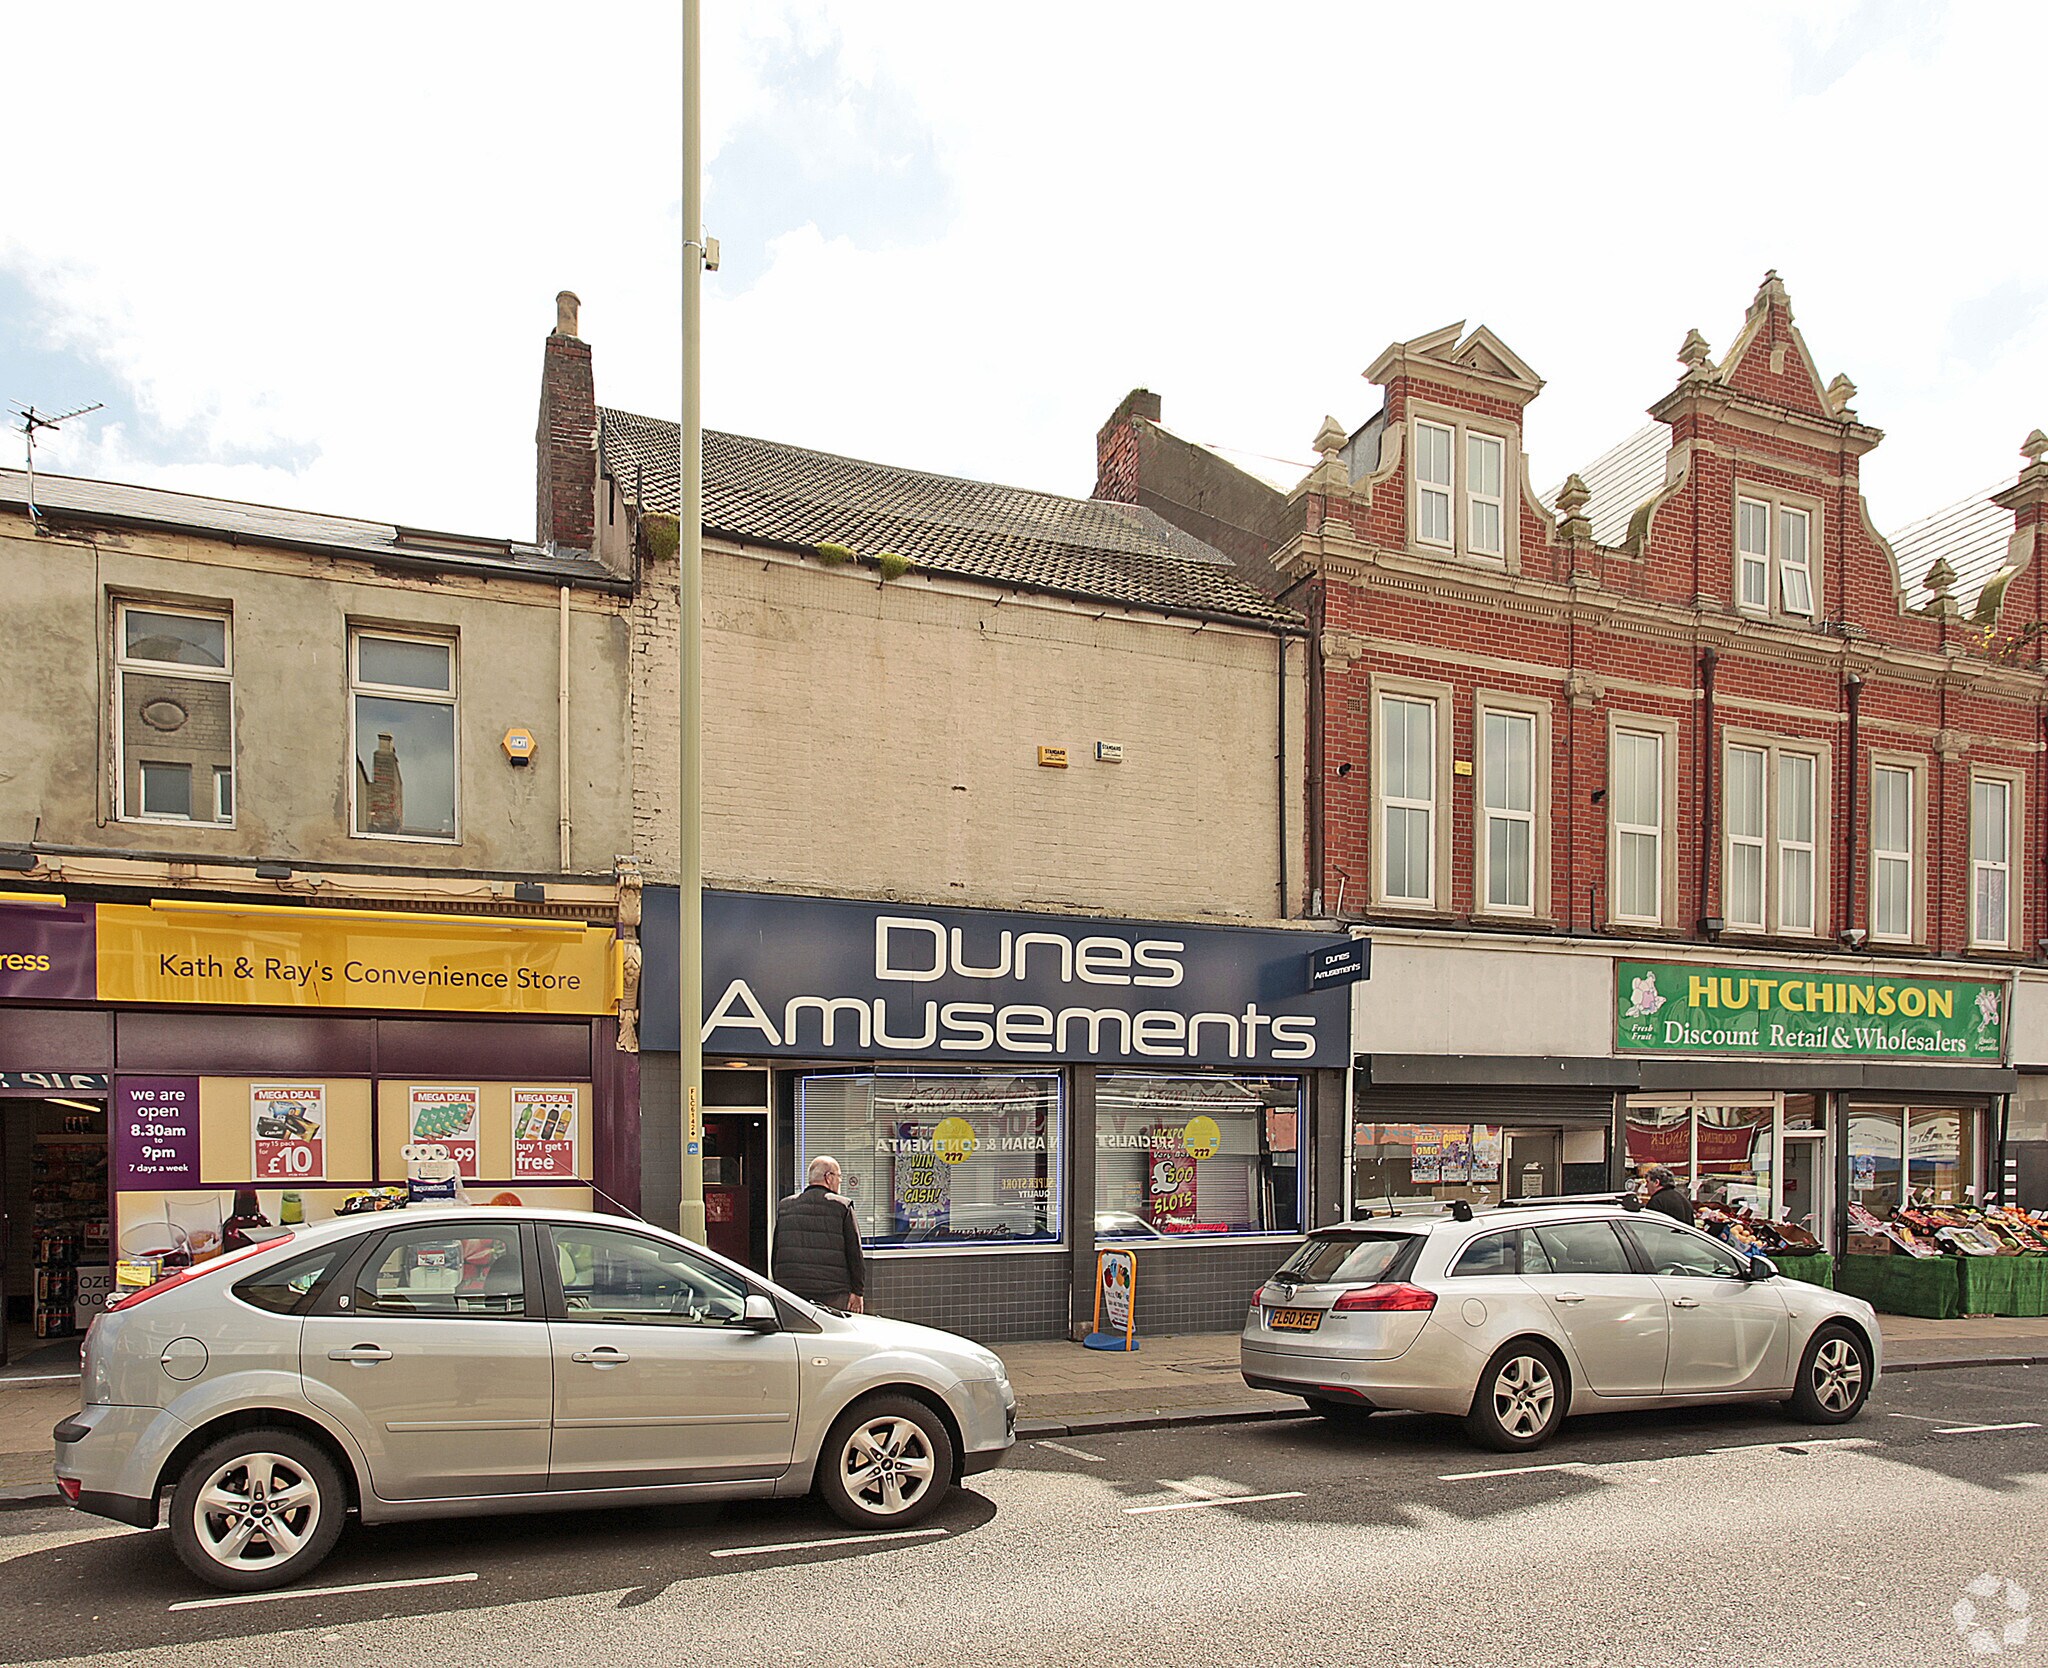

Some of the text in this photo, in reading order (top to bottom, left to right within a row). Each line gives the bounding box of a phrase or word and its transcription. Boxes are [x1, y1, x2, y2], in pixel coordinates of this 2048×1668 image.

[511, 738, 527, 748] ADT
[1102, 744, 1122, 752] STANDARD
[1044, 748, 1066, 756] STANDARD
[875, 916, 1186, 988] Dunes
[1325, 951, 1350, 965] Dunes
[160, 953, 581, 990] Kath & Ray's Convenience Store
[1314, 963, 1361, 980] Amusements
[1688, 975, 1953, 1019] HUTCHINSON
[700, 979, 1318, 1060] Amusements
[1631, 1023, 1653, 1033] Fresh
[1631, 1032, 1652, 1041] Fruit
[1664, 1020, 1966, 1053] Discount Retail & Wholesalers
[130, 1090, 185, 1101] we are
[259, 1091, 316, 1099] MEGA DEAL
[418, 1093, 471, 1102] MEGA DEAL
[518, 1094, 545, 1102] MEGA
[137, 1107, 179, 1121] open
[130, 1124, 186, 1137] 8.30am
[280, 1141, 295, 1149] pack
[516, 1141, 569, 1153] buy 1 get 1
[1416, 1146, 1438, 1155] OMG
[141, 1146, 176, 1161] 9pm
[944, 1152, 963, 1162] 777
[1193, 1148, 1210, 1157] 777
[268, 1146, 313, 1173] £10
[516, 1152, 554, 1170] free
[911, 1154, 935, 1169] WIN
[129, 1164, 135, 1172] 7
[136, 1164, 157, 1174] days
[165, 1164, 189, 1172] week
[911, 1171, 933, 1186] BIG
[904, 1188, 941, 1203] CASH!
[1154, 1191, 1193, 1214] SLOTS
[1272, 1311, 1297, 1325] FL60
[1296, 1313, 1319, 1327] XEF
